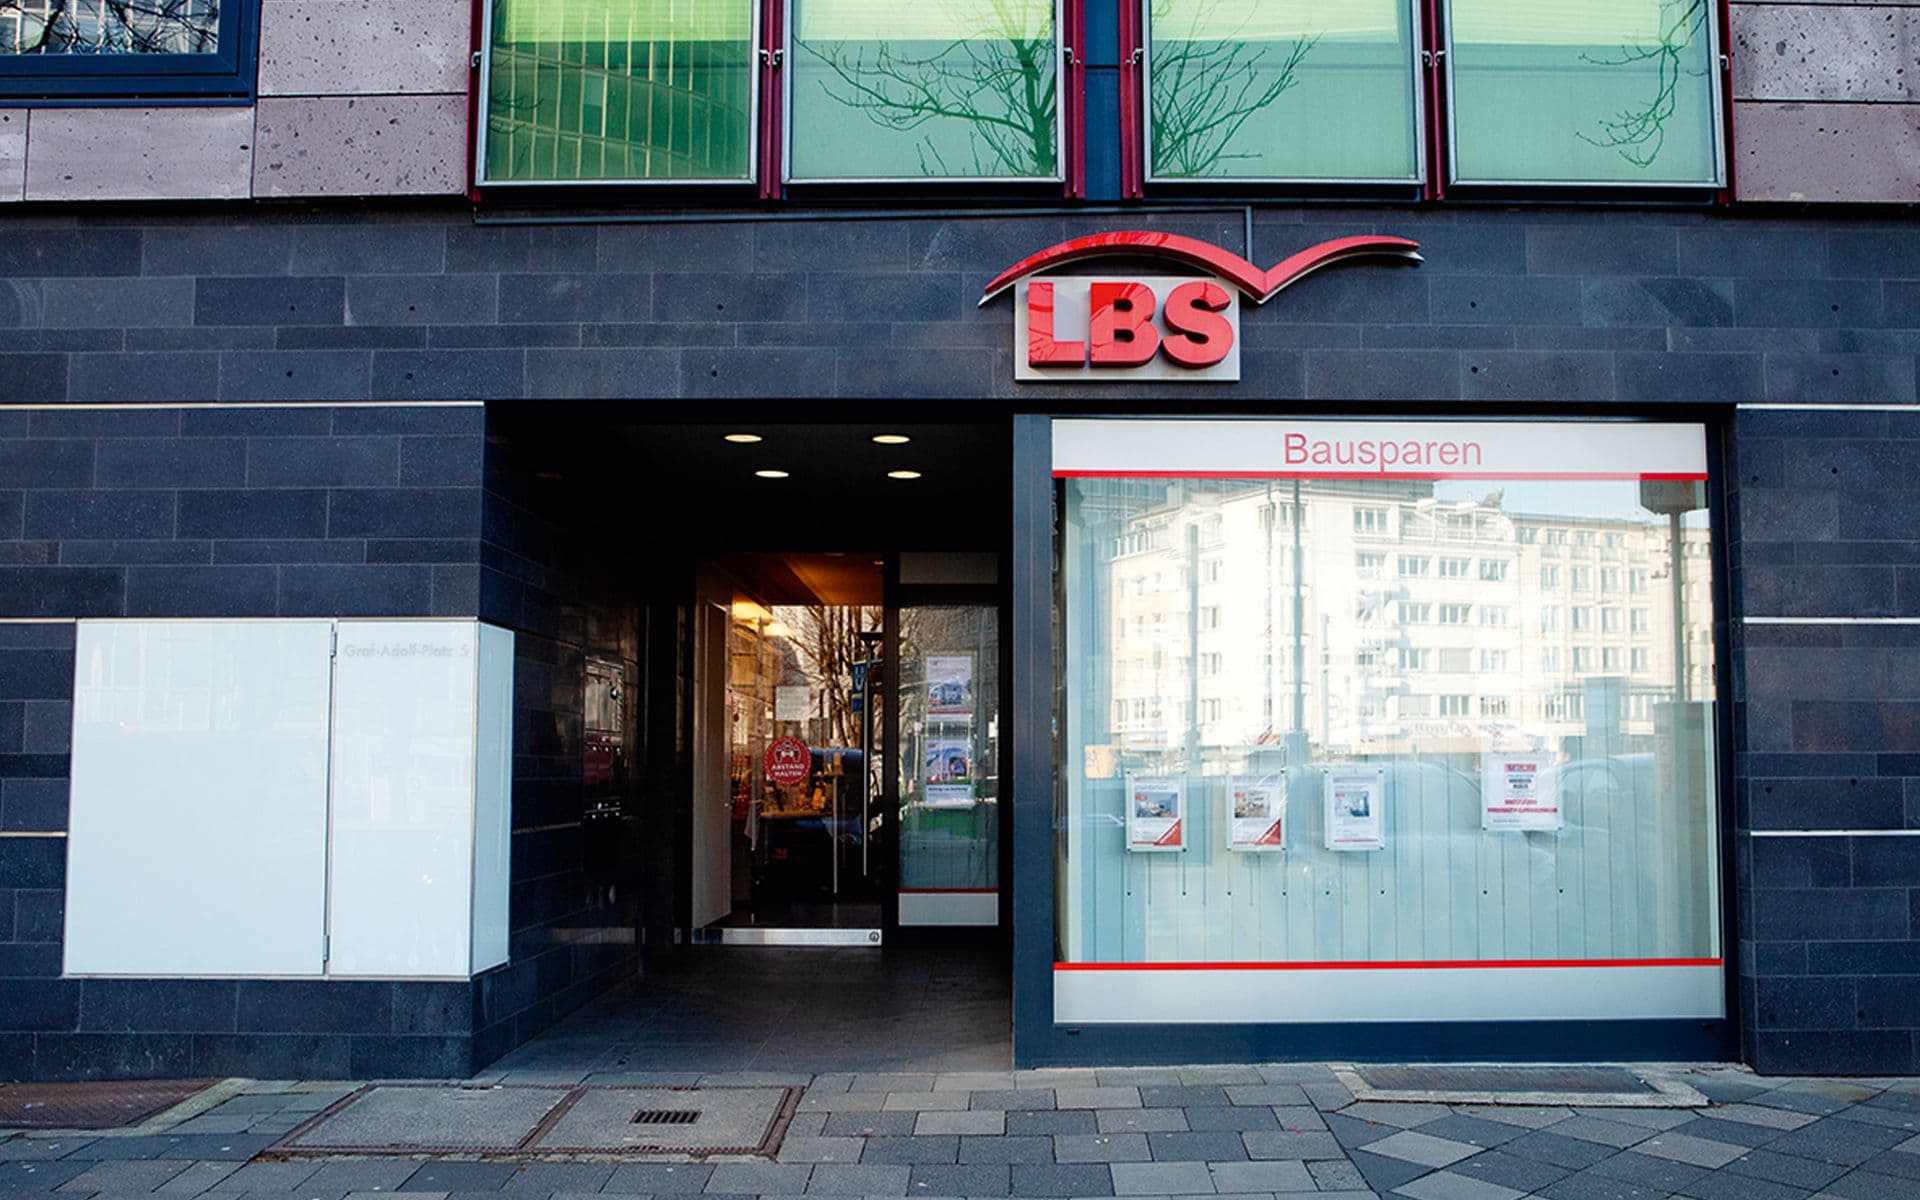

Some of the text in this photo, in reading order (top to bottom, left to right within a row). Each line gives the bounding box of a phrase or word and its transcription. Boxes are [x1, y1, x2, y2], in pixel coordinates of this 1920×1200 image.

[1028, 281, 1234, 369] LBS
[1284, 433, 1482, 473] Bausparen
[771, 763, 805, 771] ABSTAND
